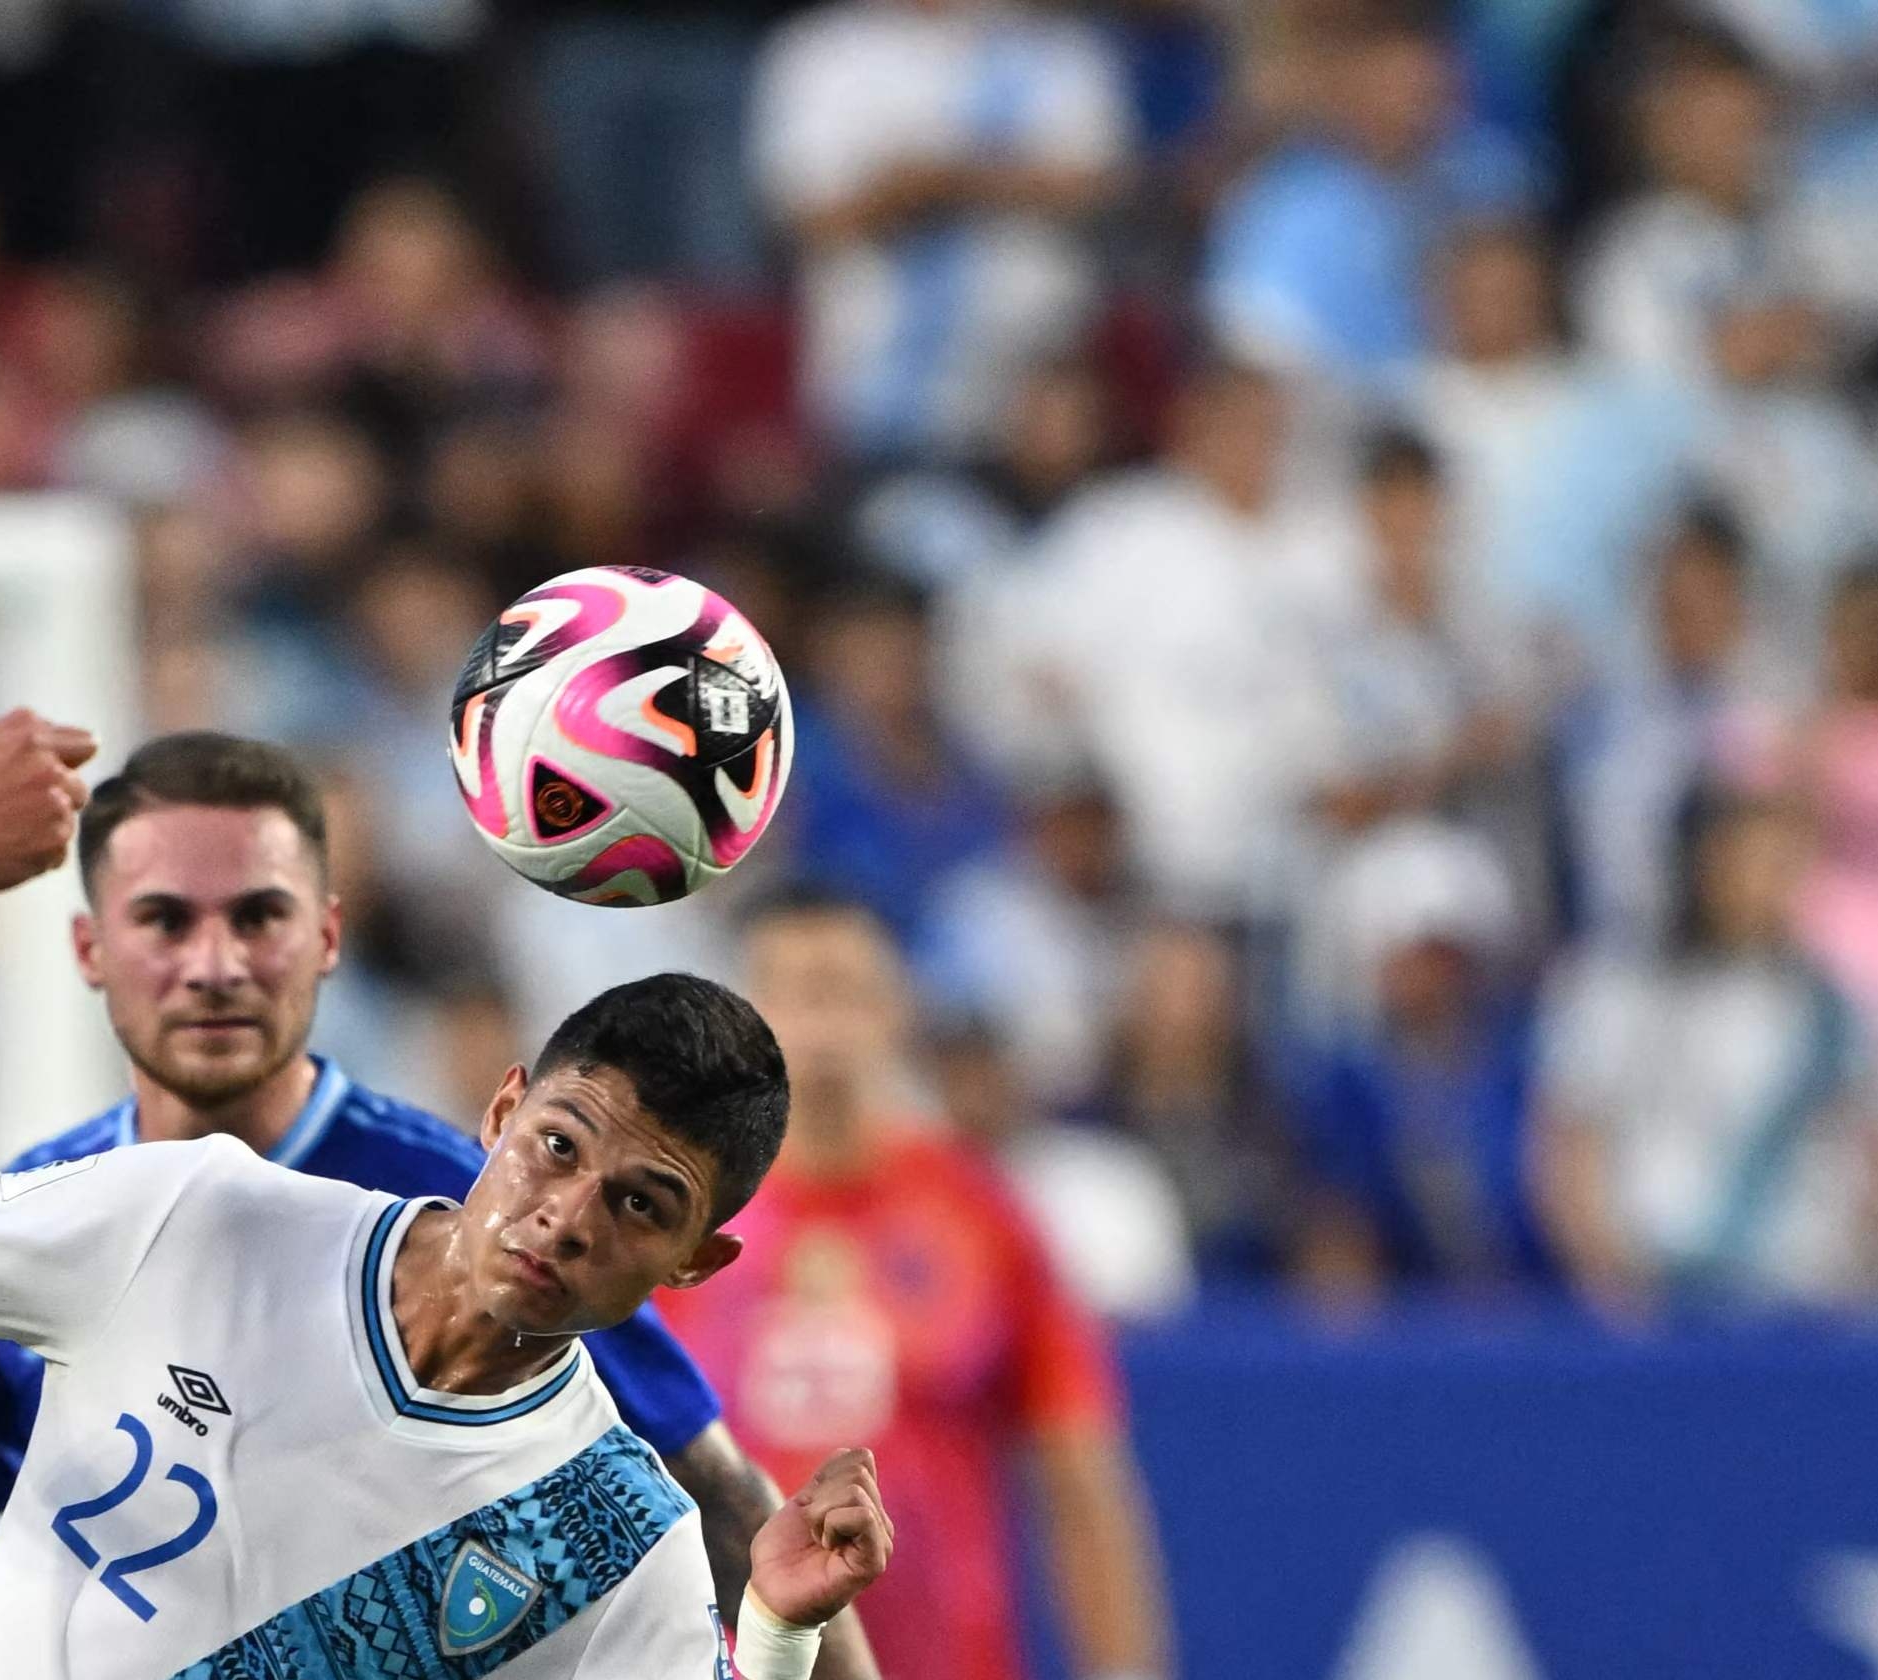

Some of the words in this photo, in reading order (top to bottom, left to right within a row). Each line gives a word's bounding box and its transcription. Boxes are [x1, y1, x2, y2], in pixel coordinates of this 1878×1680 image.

[157, 1391, 209, 1437] umbro
[51, 1412, 218, 1623] 22
[468, 1555, 527, 1600] GUATEMALA
